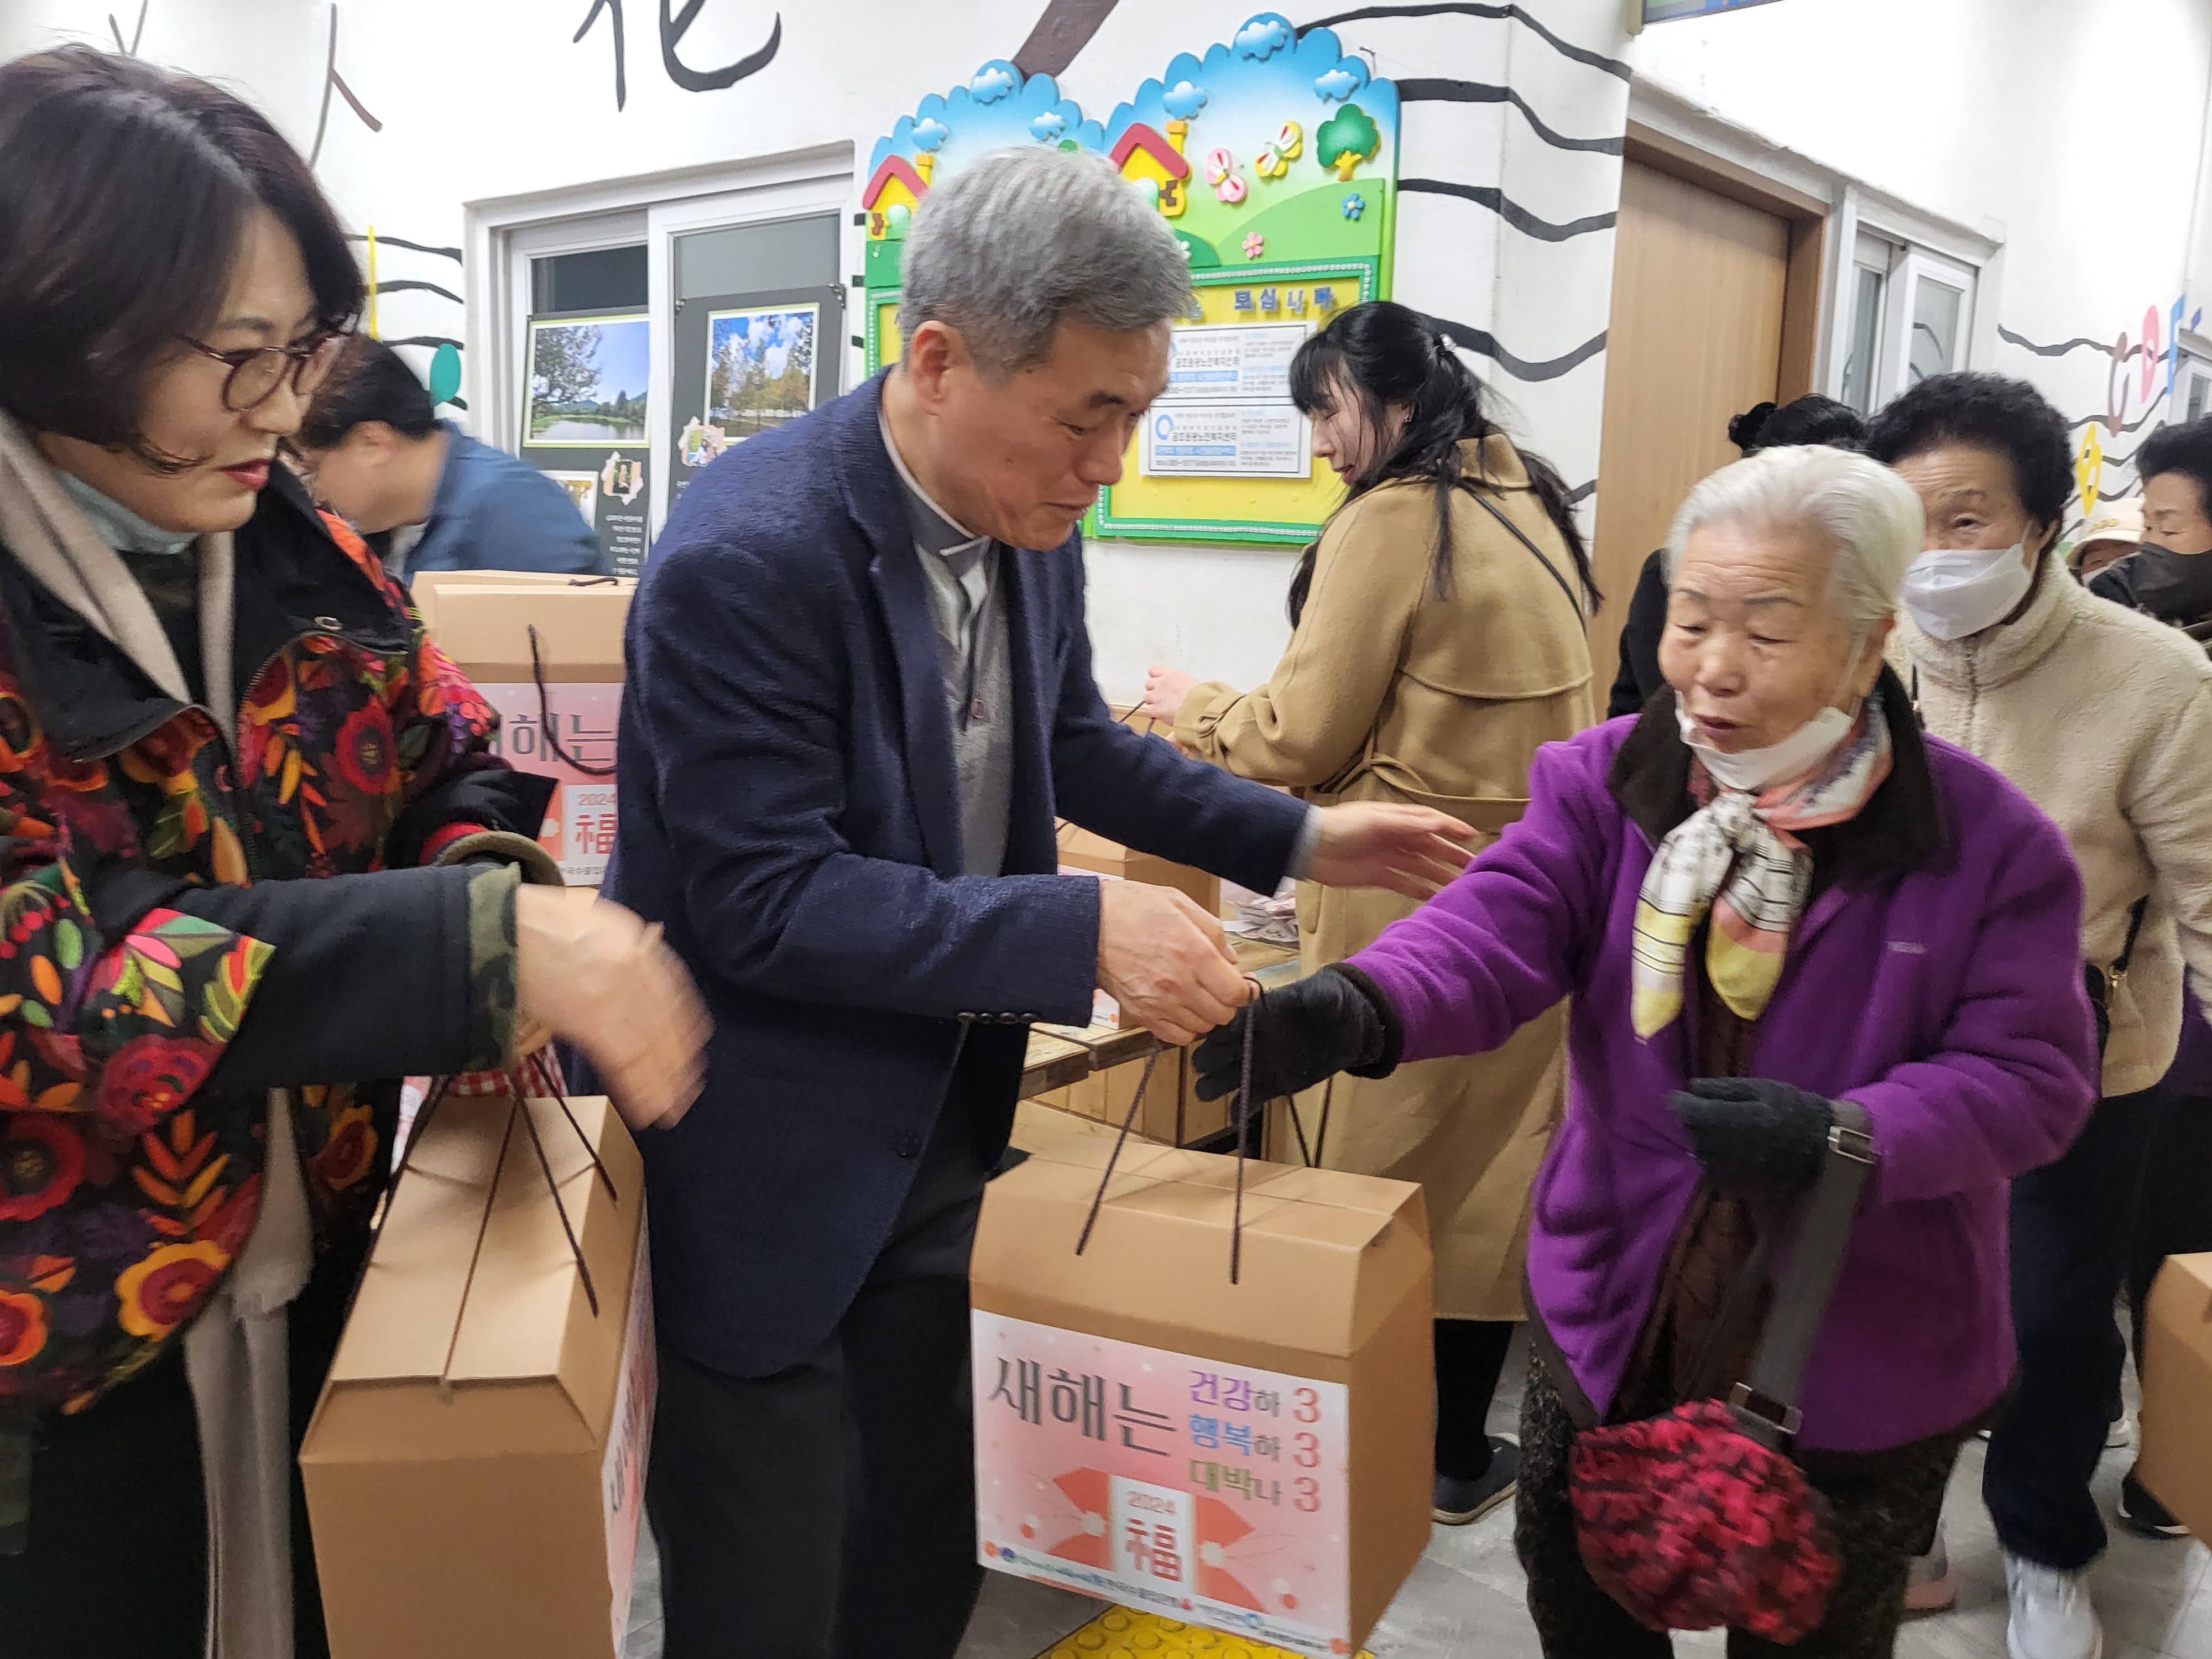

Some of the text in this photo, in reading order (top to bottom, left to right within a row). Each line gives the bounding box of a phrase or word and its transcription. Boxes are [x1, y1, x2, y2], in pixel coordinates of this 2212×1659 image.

[498, 713, 616, 763] 해는
[575, 813, 617, 854] 福
[988, 1357, 1177, 1458] 새해는
[1188, 1370, 1321, 1423] 건강하 3
[1188, 1413, 1321, 1468] 행복하 3
[1126, 1491, 1176, 1516] 2024
[1188, 1458, 1321, 1512] 대박나 3
[1125, 1517, 1182, 1582] 福
